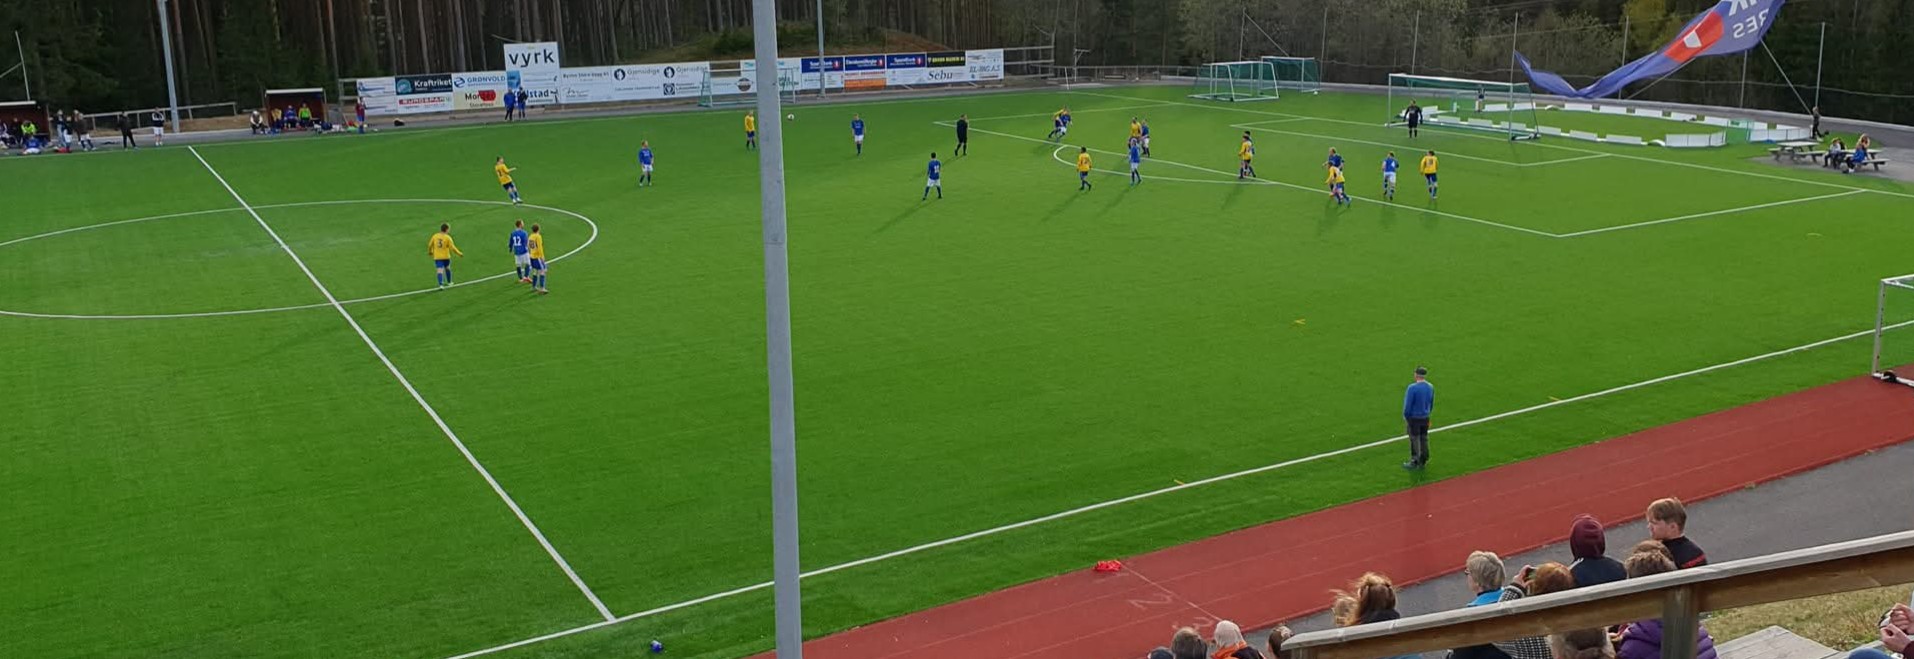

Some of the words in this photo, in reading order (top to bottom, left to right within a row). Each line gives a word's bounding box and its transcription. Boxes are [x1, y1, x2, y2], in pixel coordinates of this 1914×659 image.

[508, 49, 555, 68] vyrk
[414, 78, 452, 88] Kraftriket
[512, 236, 522, 246] 12
